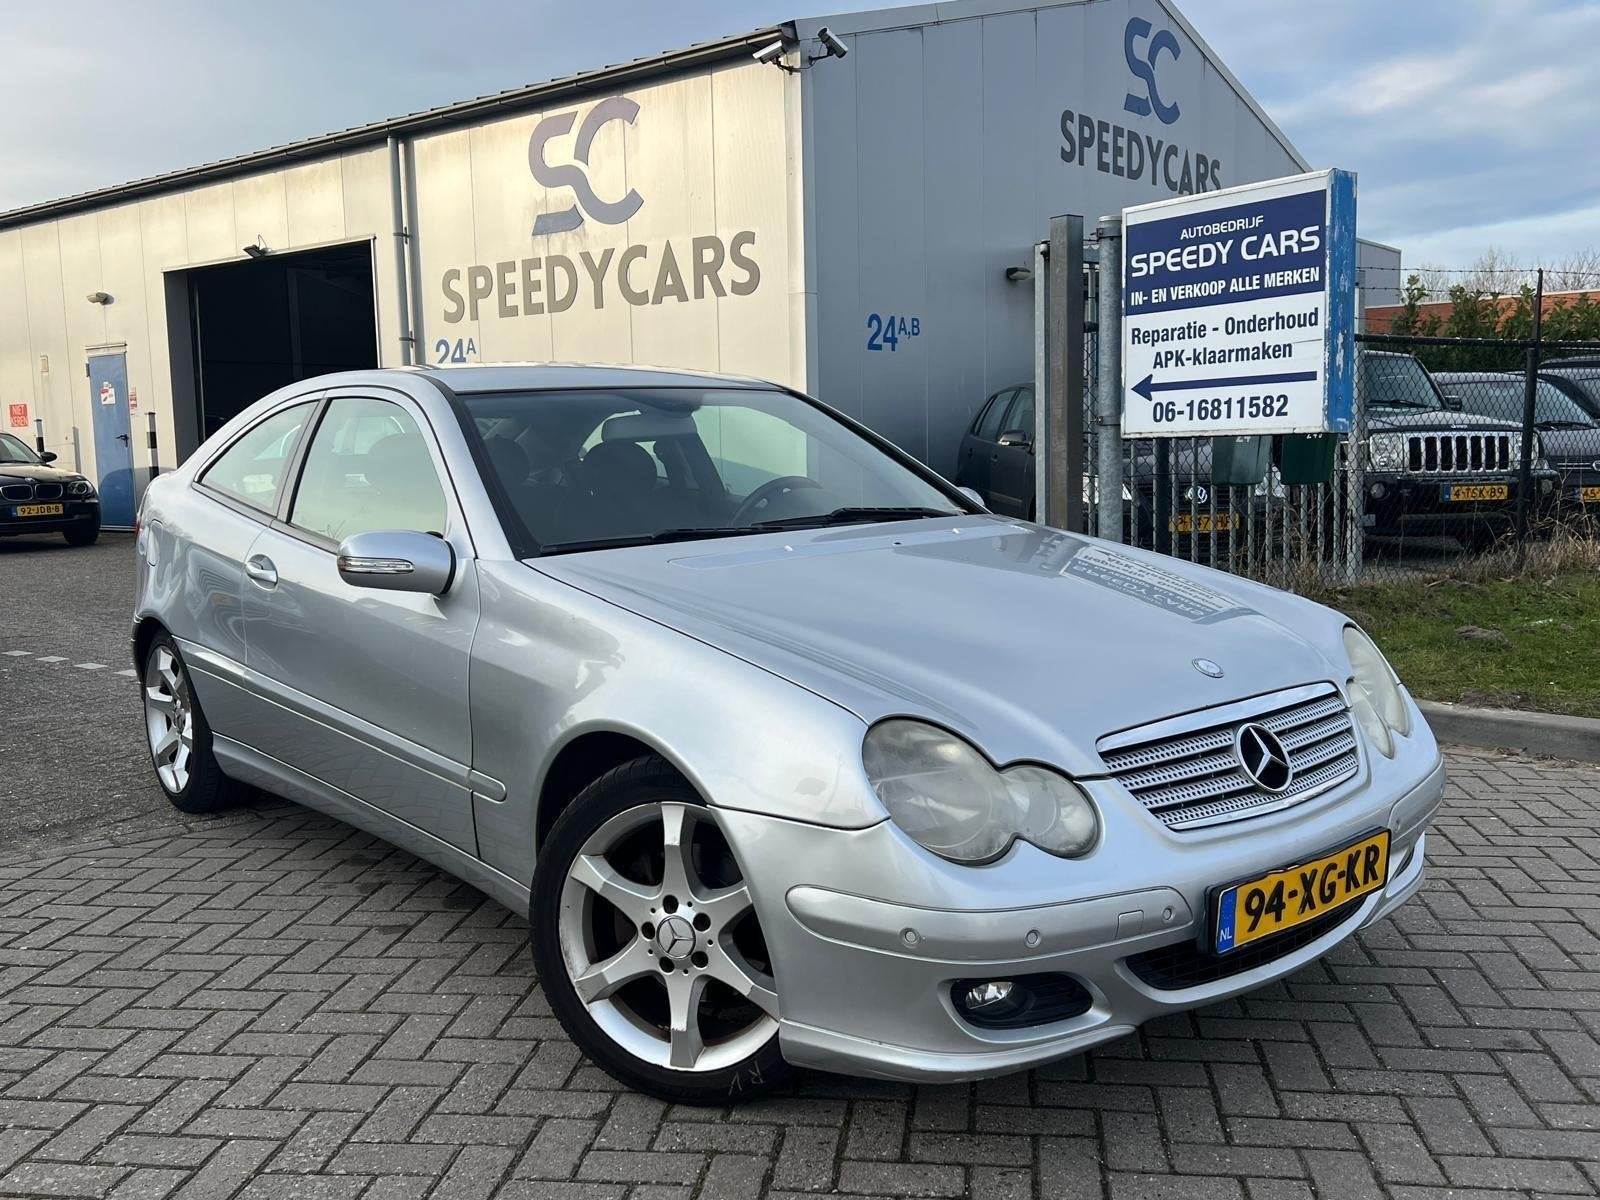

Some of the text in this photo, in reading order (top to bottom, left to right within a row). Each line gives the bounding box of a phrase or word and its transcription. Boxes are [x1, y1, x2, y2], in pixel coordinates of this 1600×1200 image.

[1060, 109, 1222, 195] SPEEDYCARS
[1180, 215, 1264, 240] AUTOBEDRIJF
[1131, 225, 1321, 278] SPEEDY CARS
[441, 230, 761, 324] SPEEDYCARS
[1131, 267, 1320, 306] IN- EN VERKOOP ALLE MERKEN
[1131, 320, 1207, 347] Reparatie
[1224, 307, 1319, 335] Onderhoud
[1153, 341, 1293, 369] APK-klaarmaken
[1152, 394, 1289, 423] 06-16811582
[1582, 488, 1600, 498] 45-
[1244, 844, 1380, 933] 94-XG-KR
[1219, 924, 1233, 943] NL
